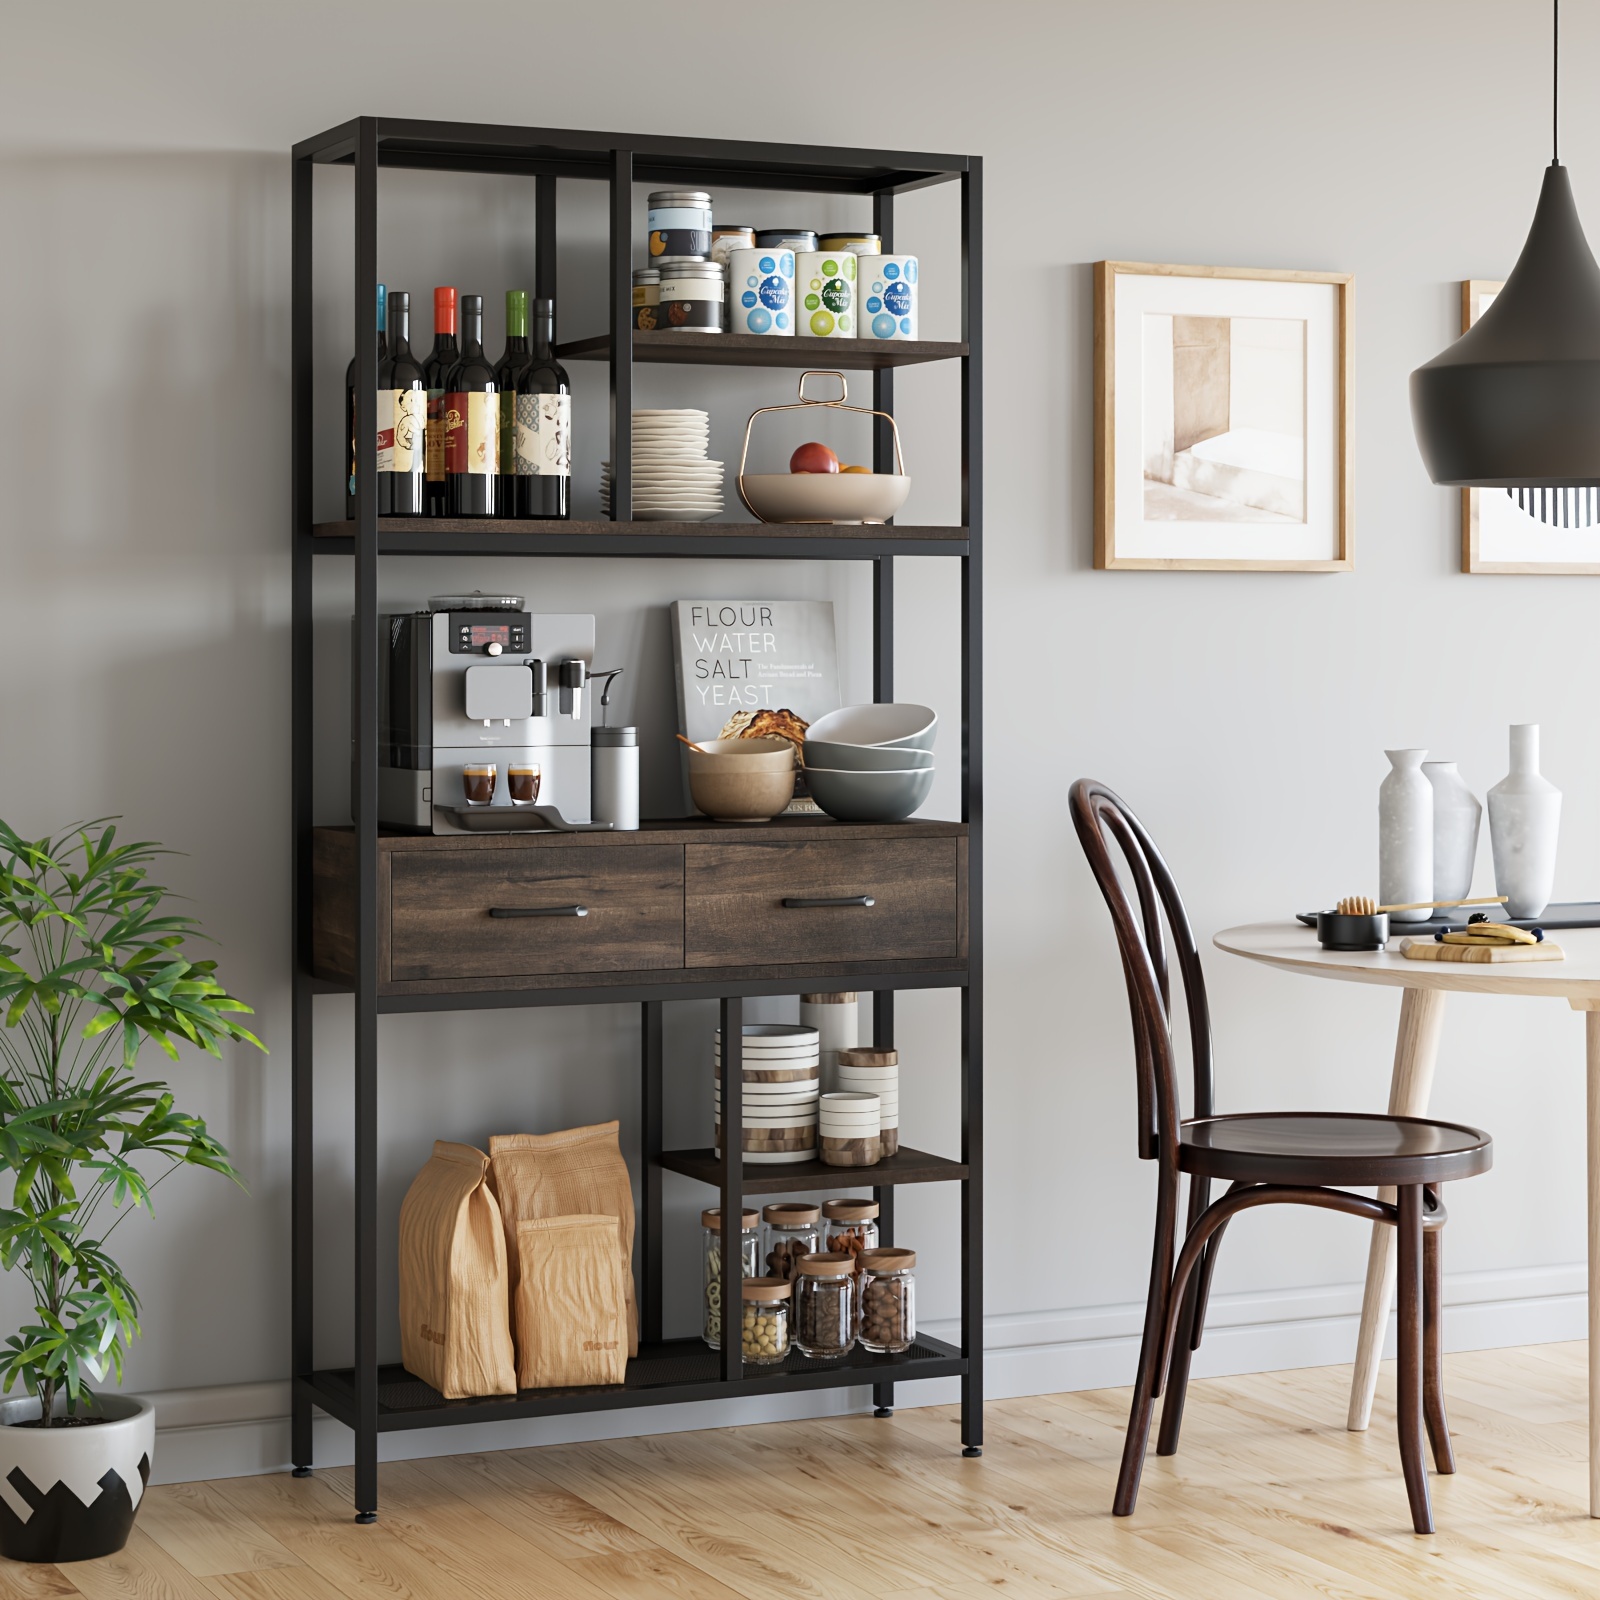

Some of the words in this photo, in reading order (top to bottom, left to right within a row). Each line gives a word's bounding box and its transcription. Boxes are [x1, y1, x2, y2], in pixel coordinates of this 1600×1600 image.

[771, 294, 785, 304] Mix
[834, 297, 849, 307] Mix
[896, 300, 910, 310] Mix
[691, 607, 773, 627] FLOUR
[692, 632, 777, 653] WATER
[695, 658, 752, 679] SALT
[695, 684, 774, 706] YEAST
[787, 804, 803, 812] KEN
[804, 804, 822, 812] FOR
[582, 1339, 619, 1352] flour
